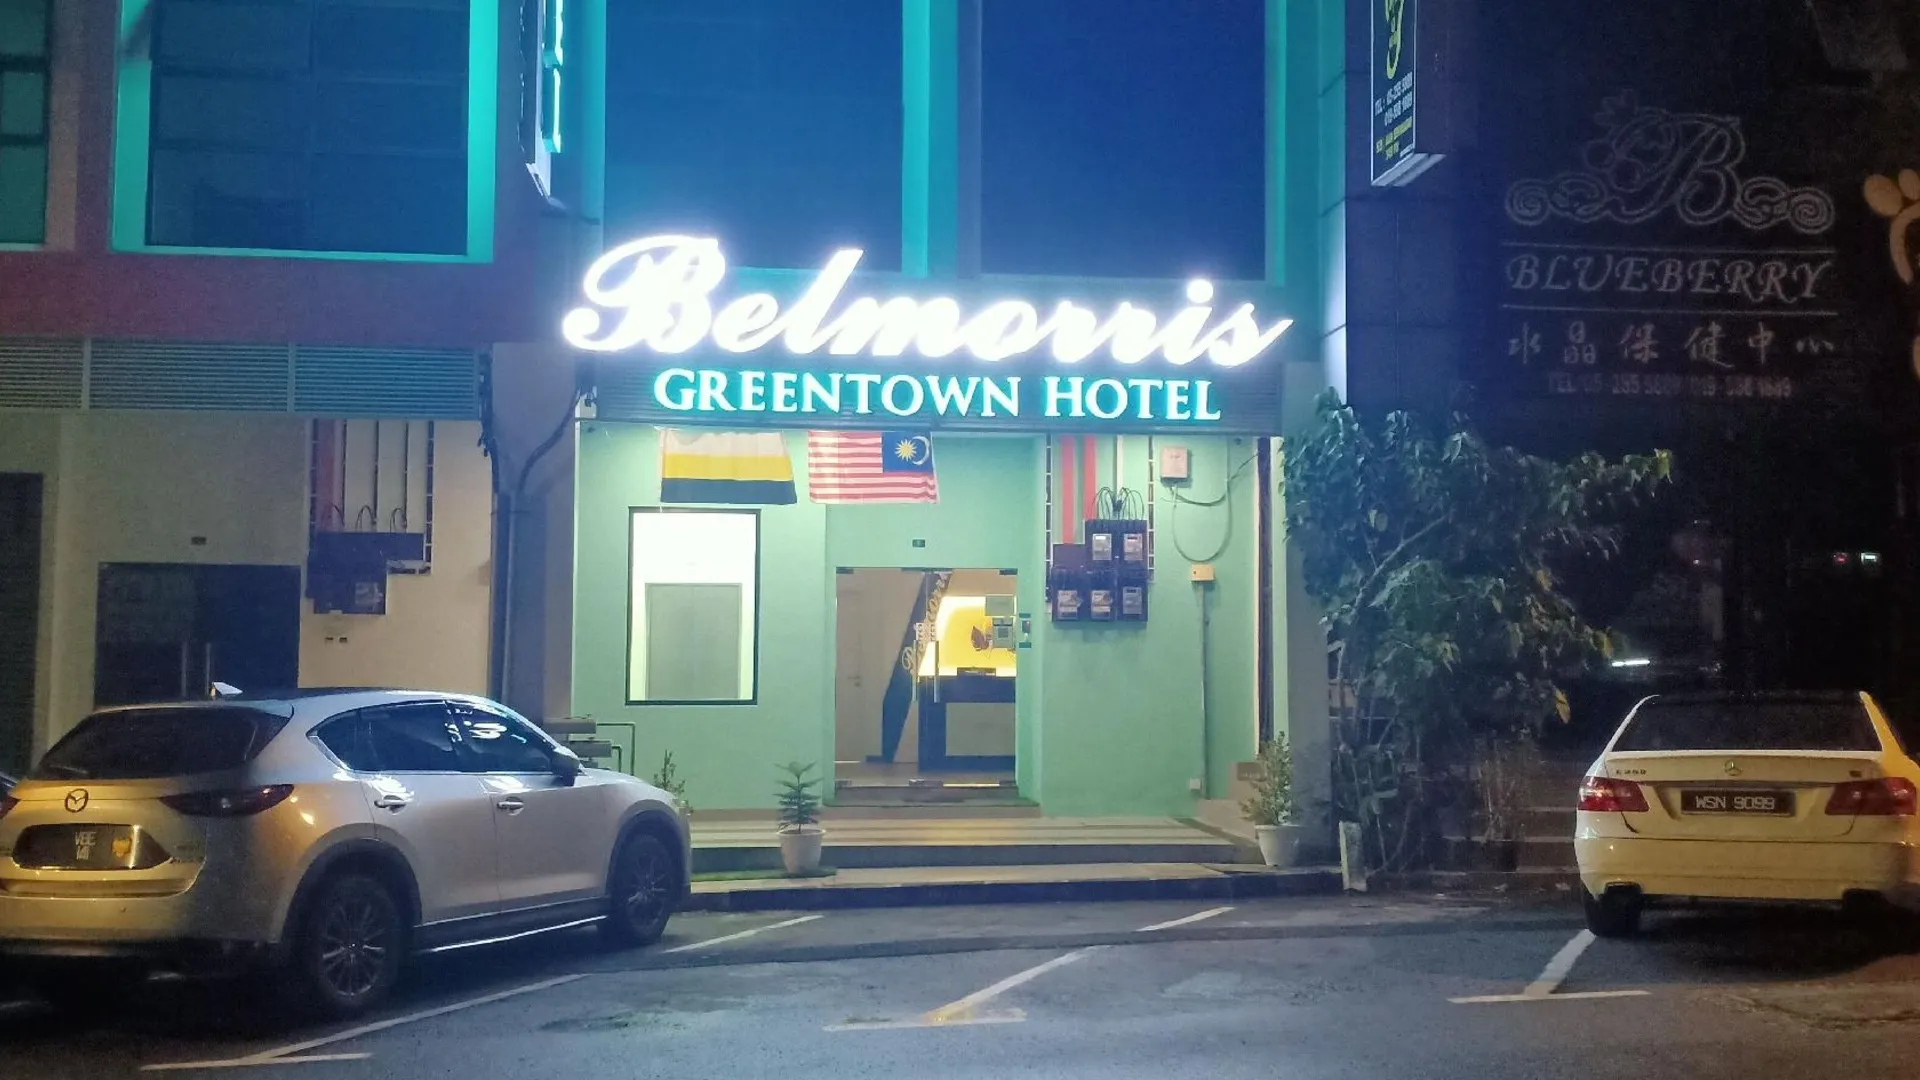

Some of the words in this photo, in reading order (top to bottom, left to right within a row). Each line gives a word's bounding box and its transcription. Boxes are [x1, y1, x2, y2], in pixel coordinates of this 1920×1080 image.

[562, 234, 1294, 368] Belmorris
[1504, 253, 1832, 304] BLUEBERRY
[1508, 320, 1836, 369] 水晶保健中心
[653, 368, 1022, 418] GREENTOWN
[1044, 376, 1222, 421] HOTEL
[1695, 795, 1726, 809] WSN
[1733, 796, 1775, 810] 9099
